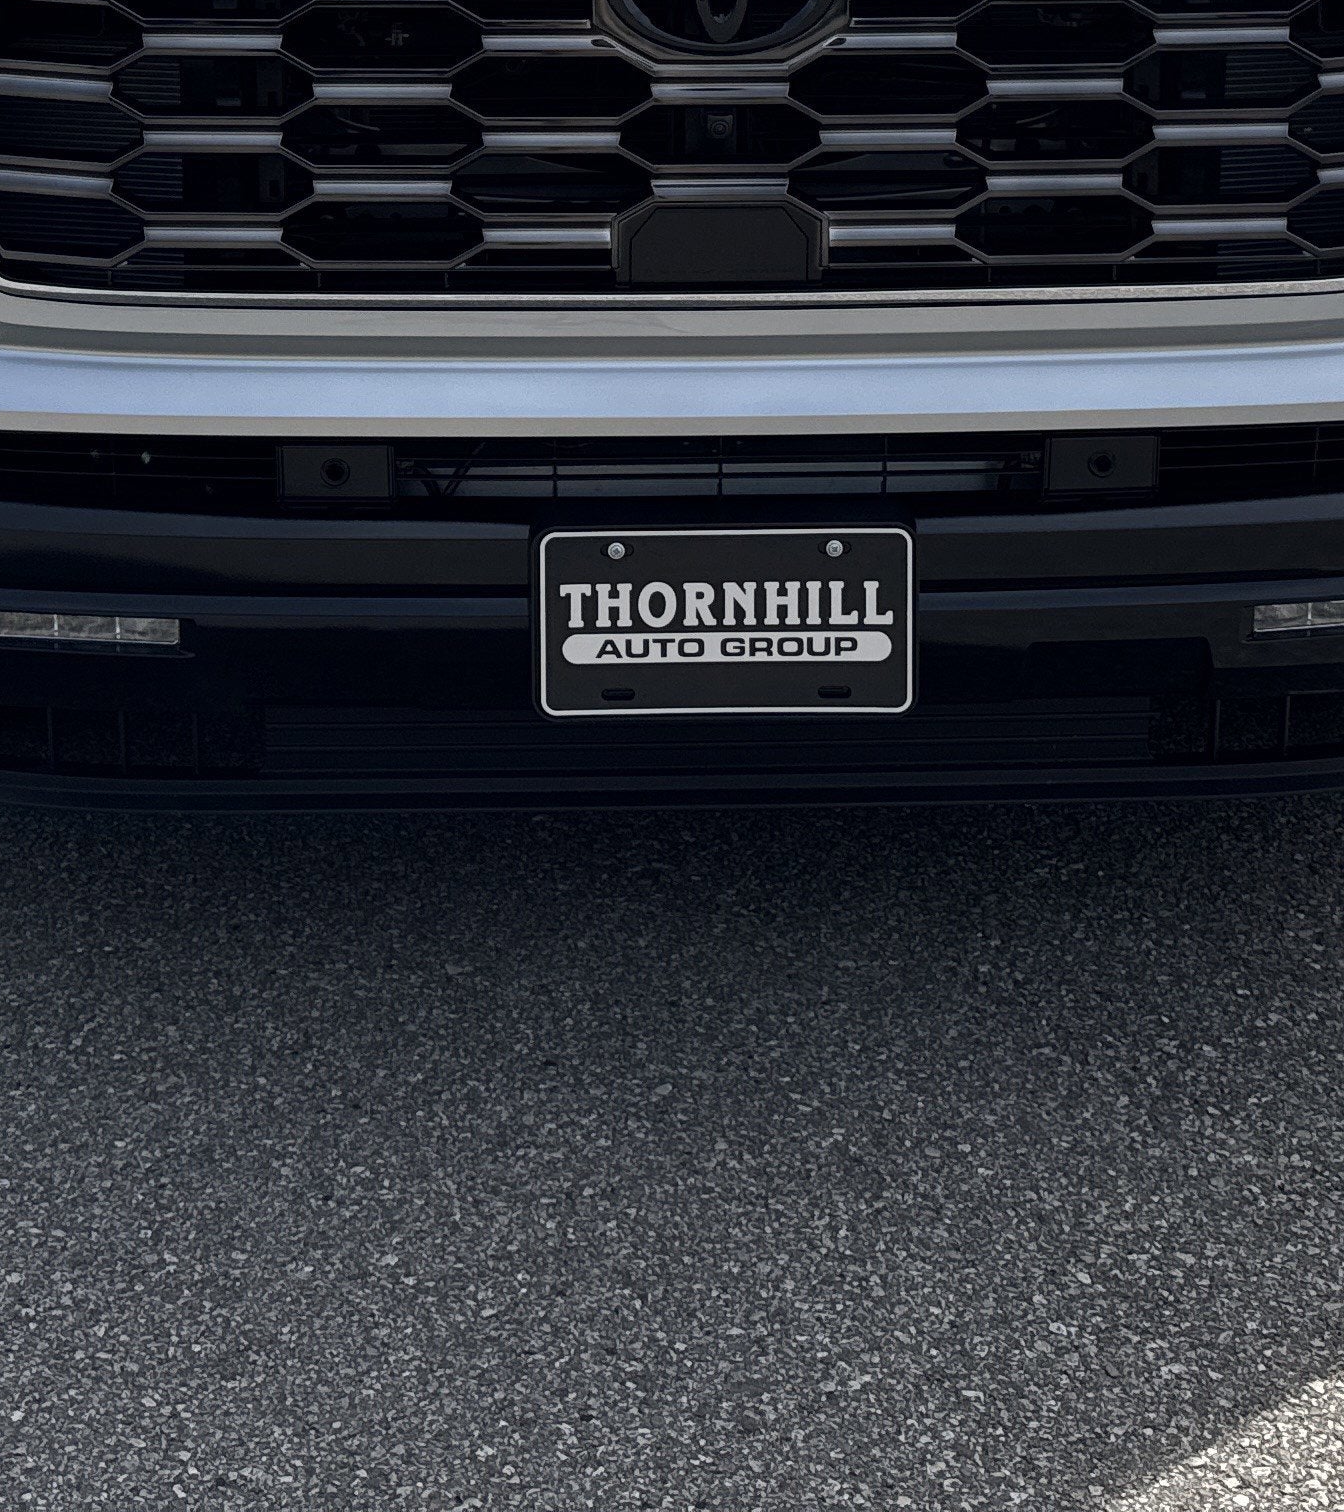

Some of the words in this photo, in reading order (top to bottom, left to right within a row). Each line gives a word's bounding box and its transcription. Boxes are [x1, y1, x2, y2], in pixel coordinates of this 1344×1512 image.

[559, 581, 894, 628] THORNHILL
[595, 637, 705, 659] AUTO
[720, 636, 858, 658] GROUP
